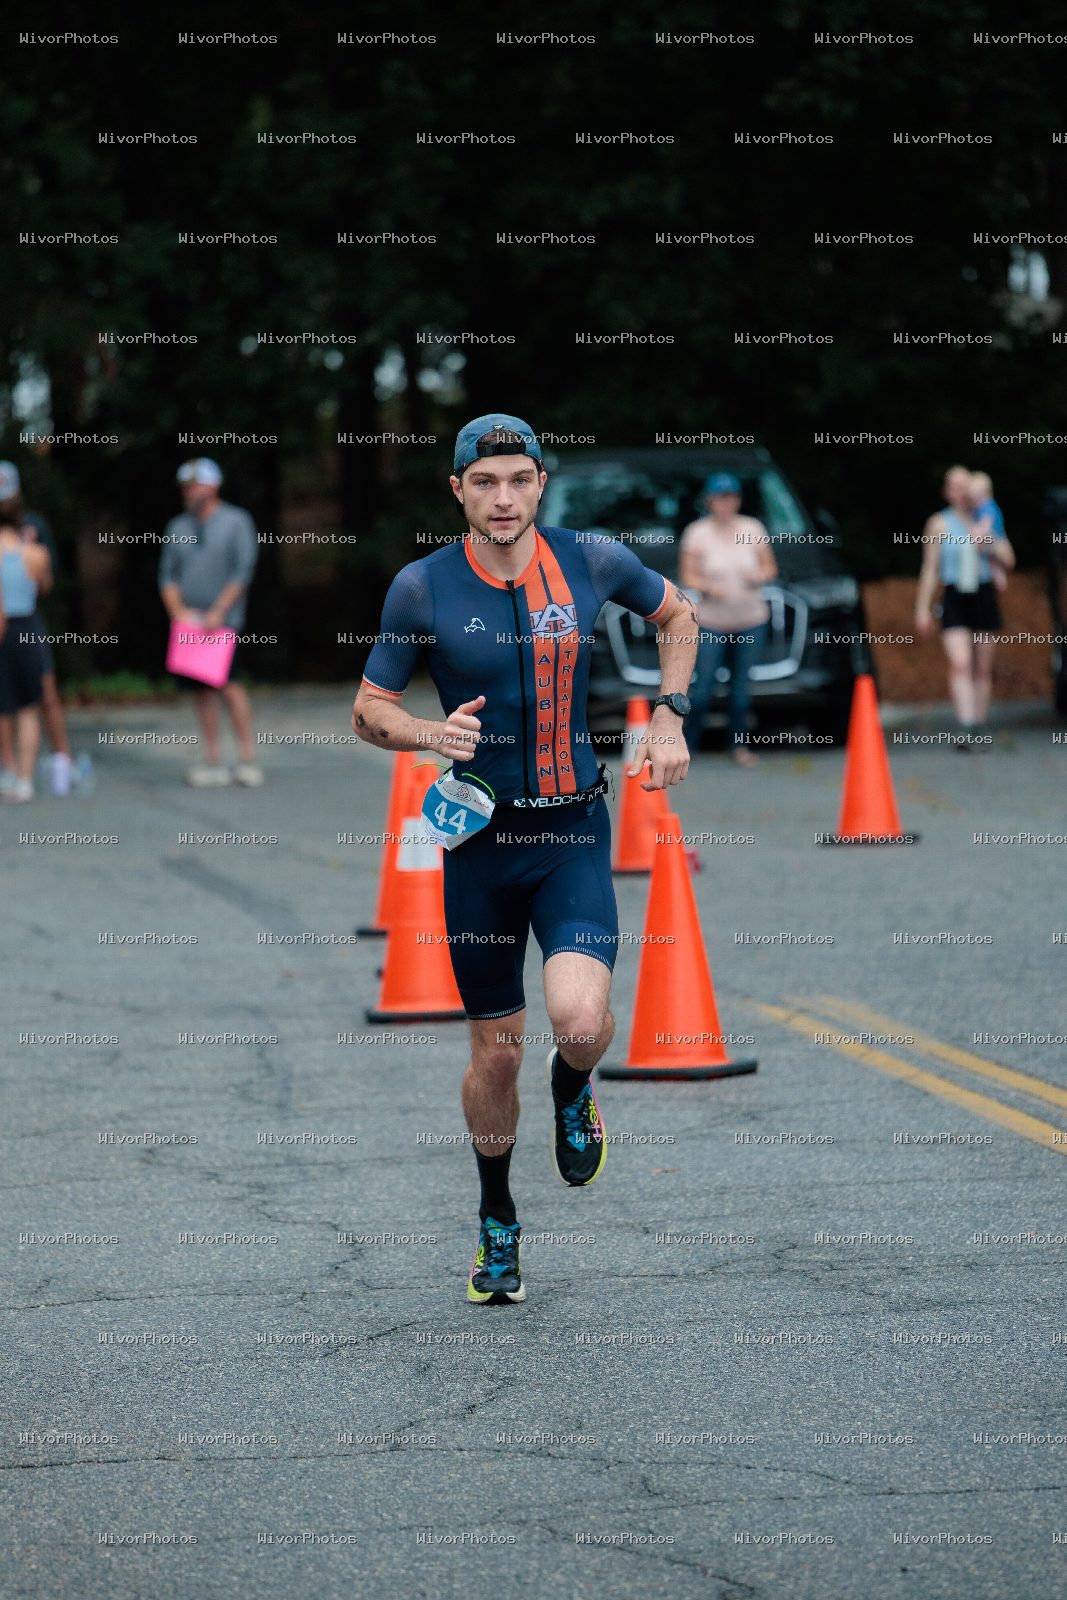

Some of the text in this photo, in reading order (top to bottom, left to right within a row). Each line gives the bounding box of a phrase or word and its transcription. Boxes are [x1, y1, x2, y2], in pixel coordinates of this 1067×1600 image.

[537, 653, 553, 778] AUBURN
[559, 649, 574, 774] TRIATHLON
[433, 801, 468, 835] 44
